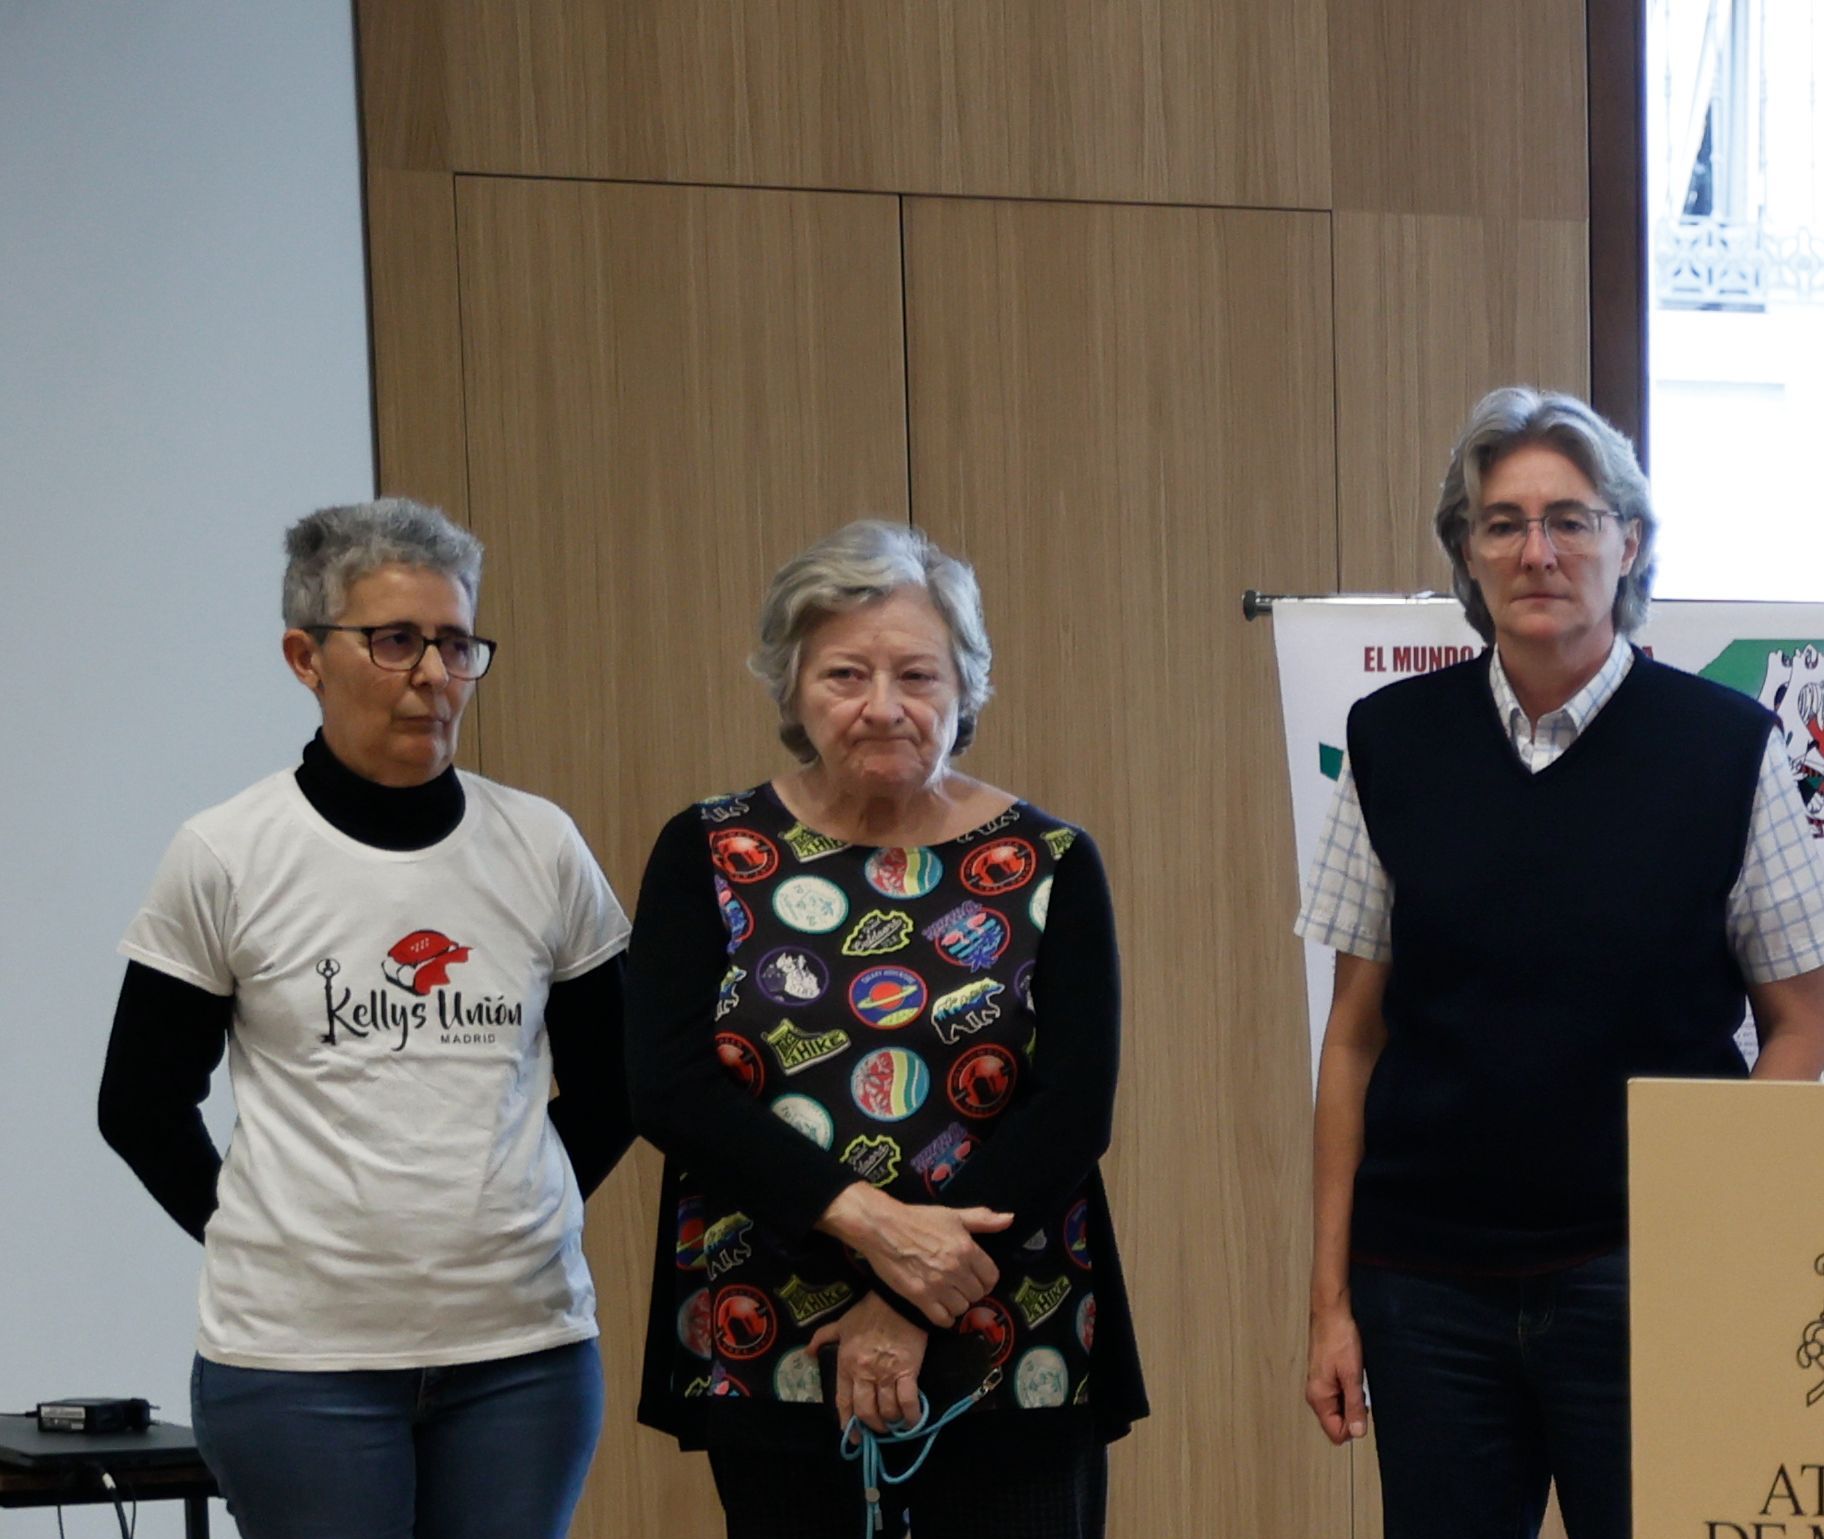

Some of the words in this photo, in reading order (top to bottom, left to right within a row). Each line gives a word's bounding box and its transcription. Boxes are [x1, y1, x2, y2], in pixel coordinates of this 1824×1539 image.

[1363, 646, 1386, 672] EL
[320, 984, 427, 1051] Kellys
[438, 989, 522, 1030] Unión
[441, 1034, 496, 1044] MADRID
